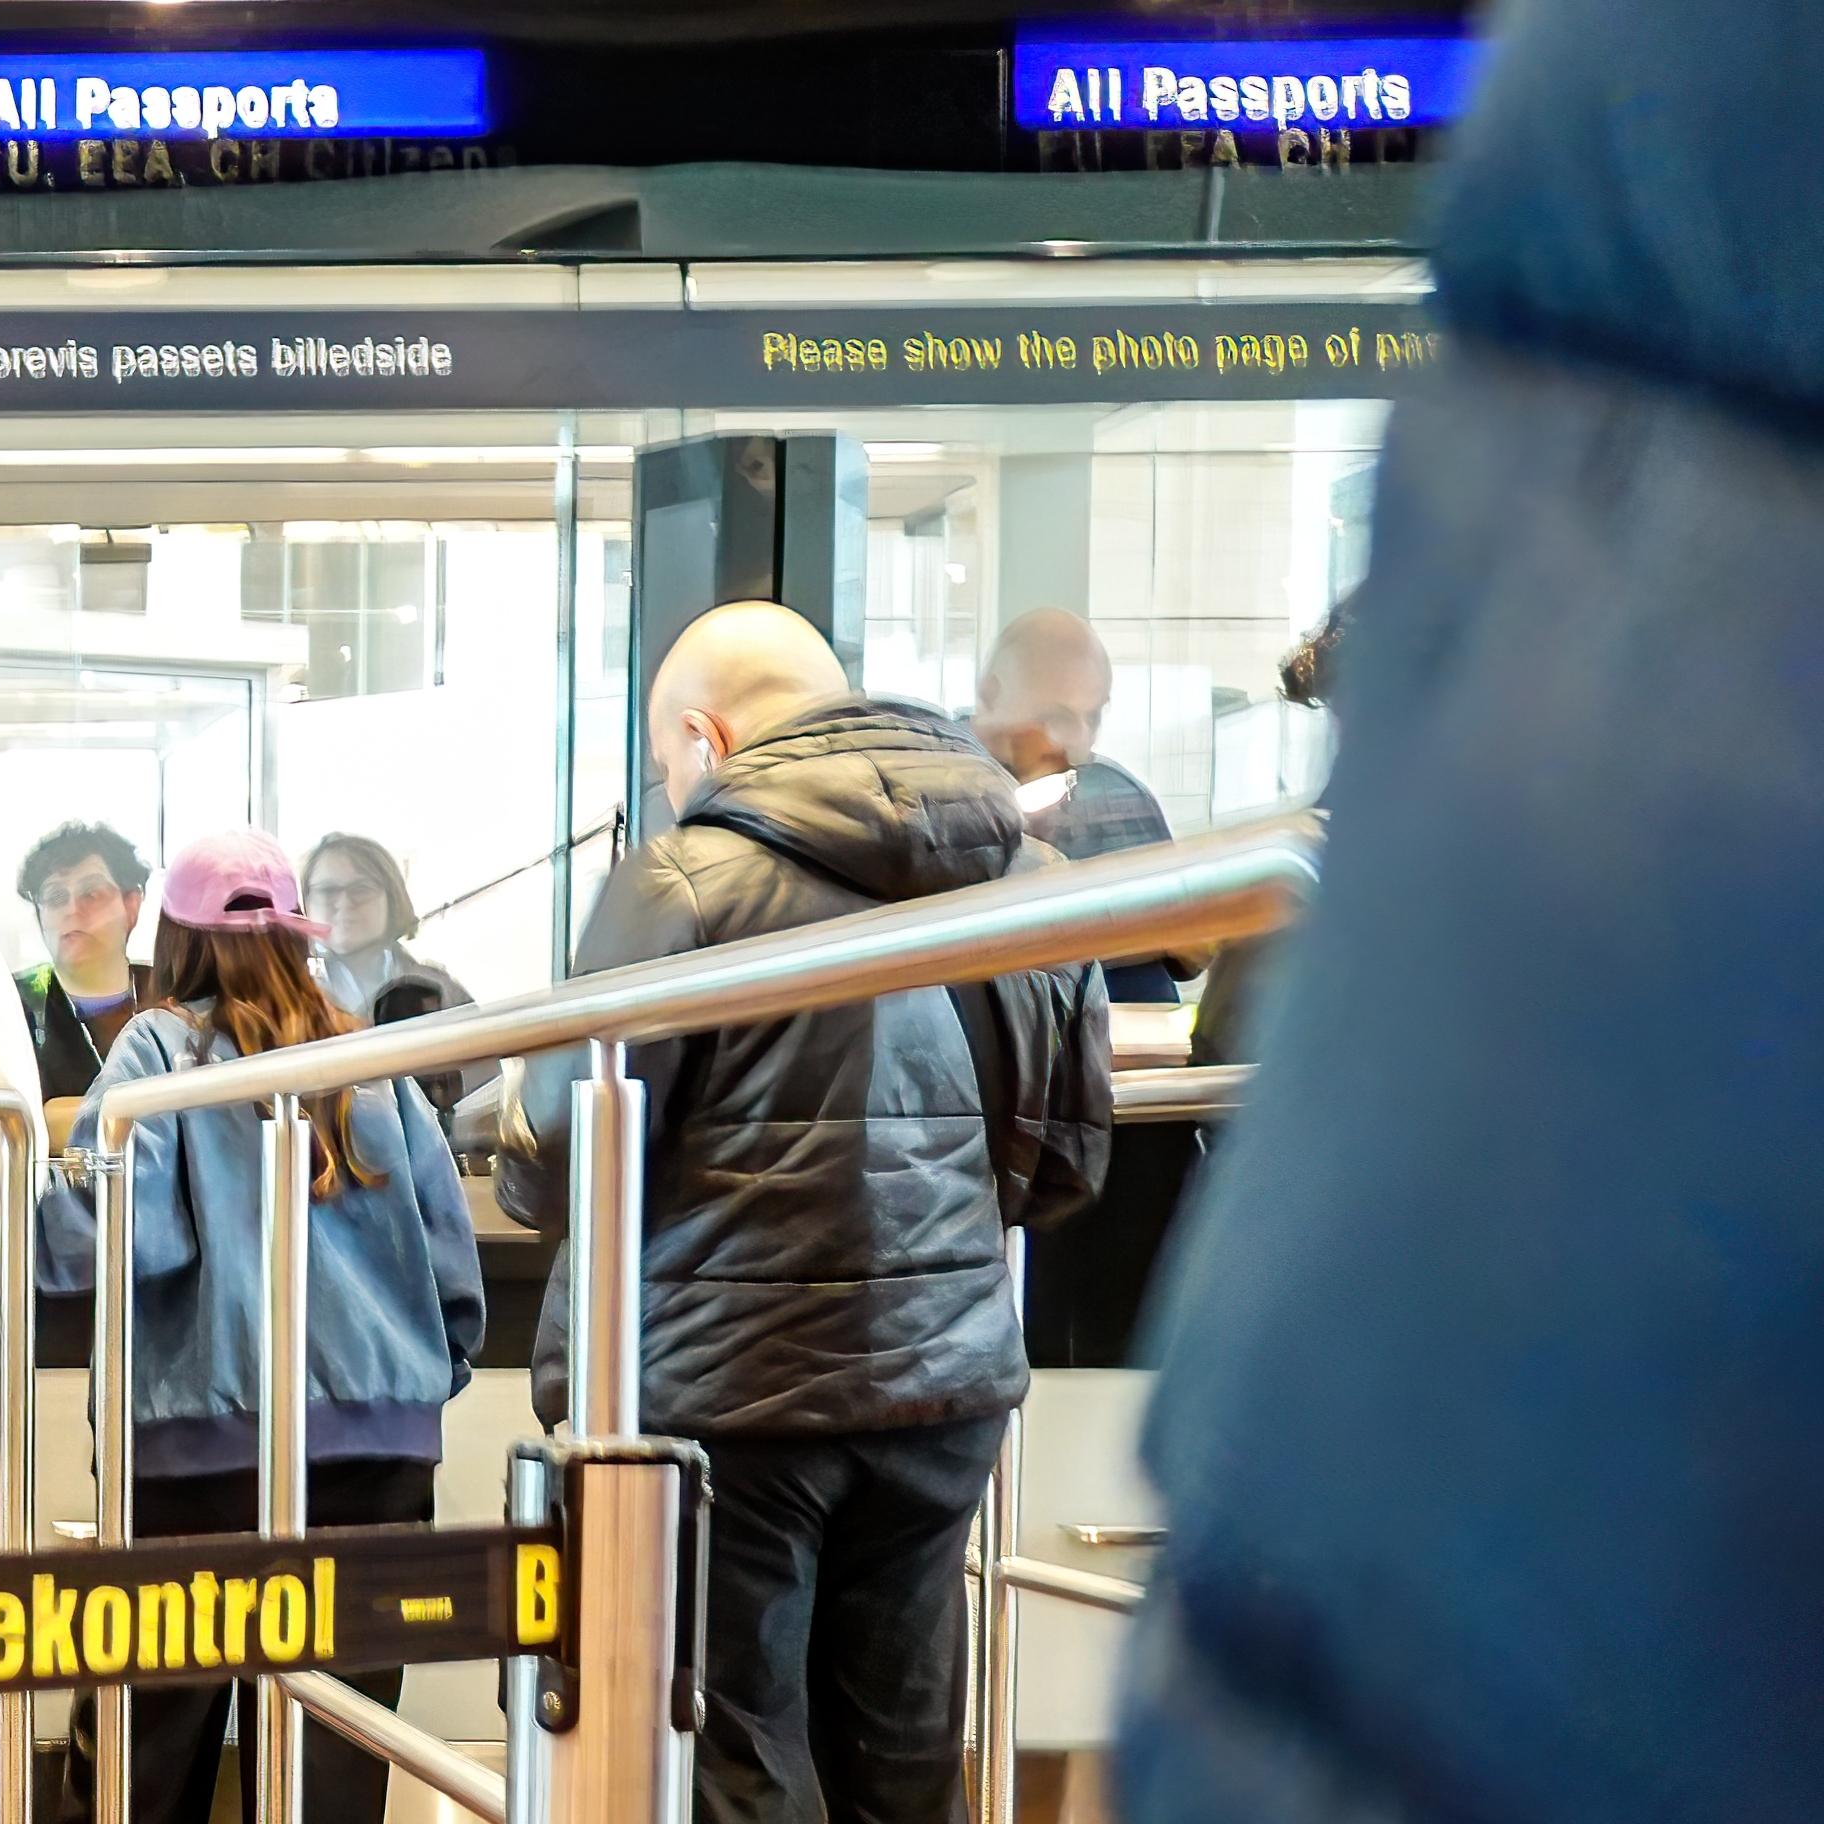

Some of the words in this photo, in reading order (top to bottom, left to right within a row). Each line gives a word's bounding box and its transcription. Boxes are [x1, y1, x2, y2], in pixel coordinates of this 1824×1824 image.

[76, 77, 339, 139] Passports
[1047, 67, 1121, 122] All
[1143, 66, 1411, 130] Passports
[112, 340, 258, 384] passets
[271, 336, 452, 378] billedside
[763, 332, 888, 372] Please
[903, 330, 1002, 371] show
[1017, 330, 1077, 370] the
[1092, 329, 1199, 375] photo
[1215, 334, 1309, 375] page
[1325, 327, 1360, 368] of
